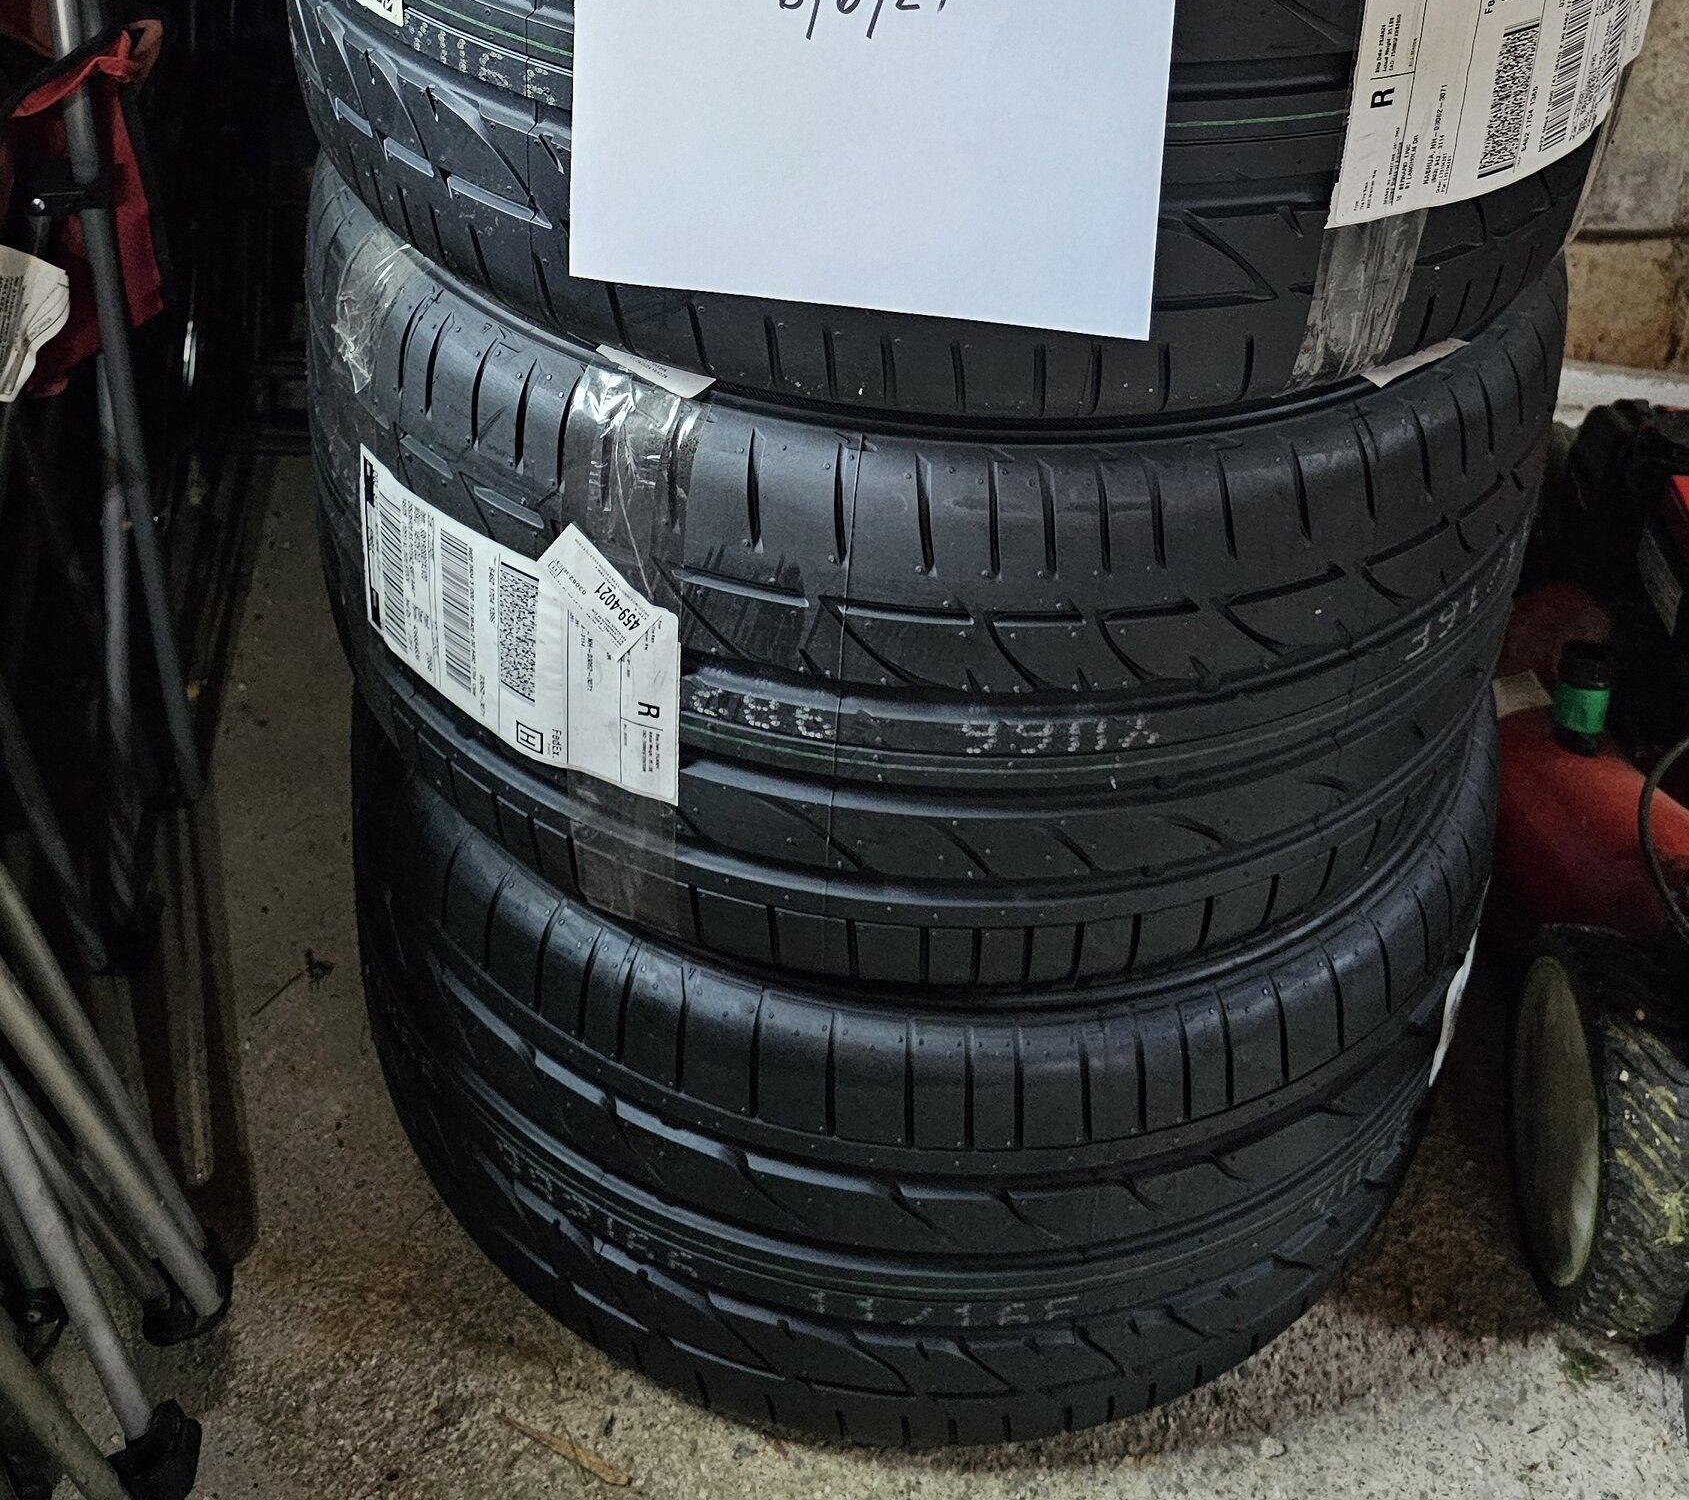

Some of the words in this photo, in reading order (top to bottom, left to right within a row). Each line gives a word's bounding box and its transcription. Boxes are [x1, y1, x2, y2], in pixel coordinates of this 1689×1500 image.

[1370, 86, 1395, 108] R
[593, 580, 642, 634] 459-4021
[638, 701, 660, 720] R
